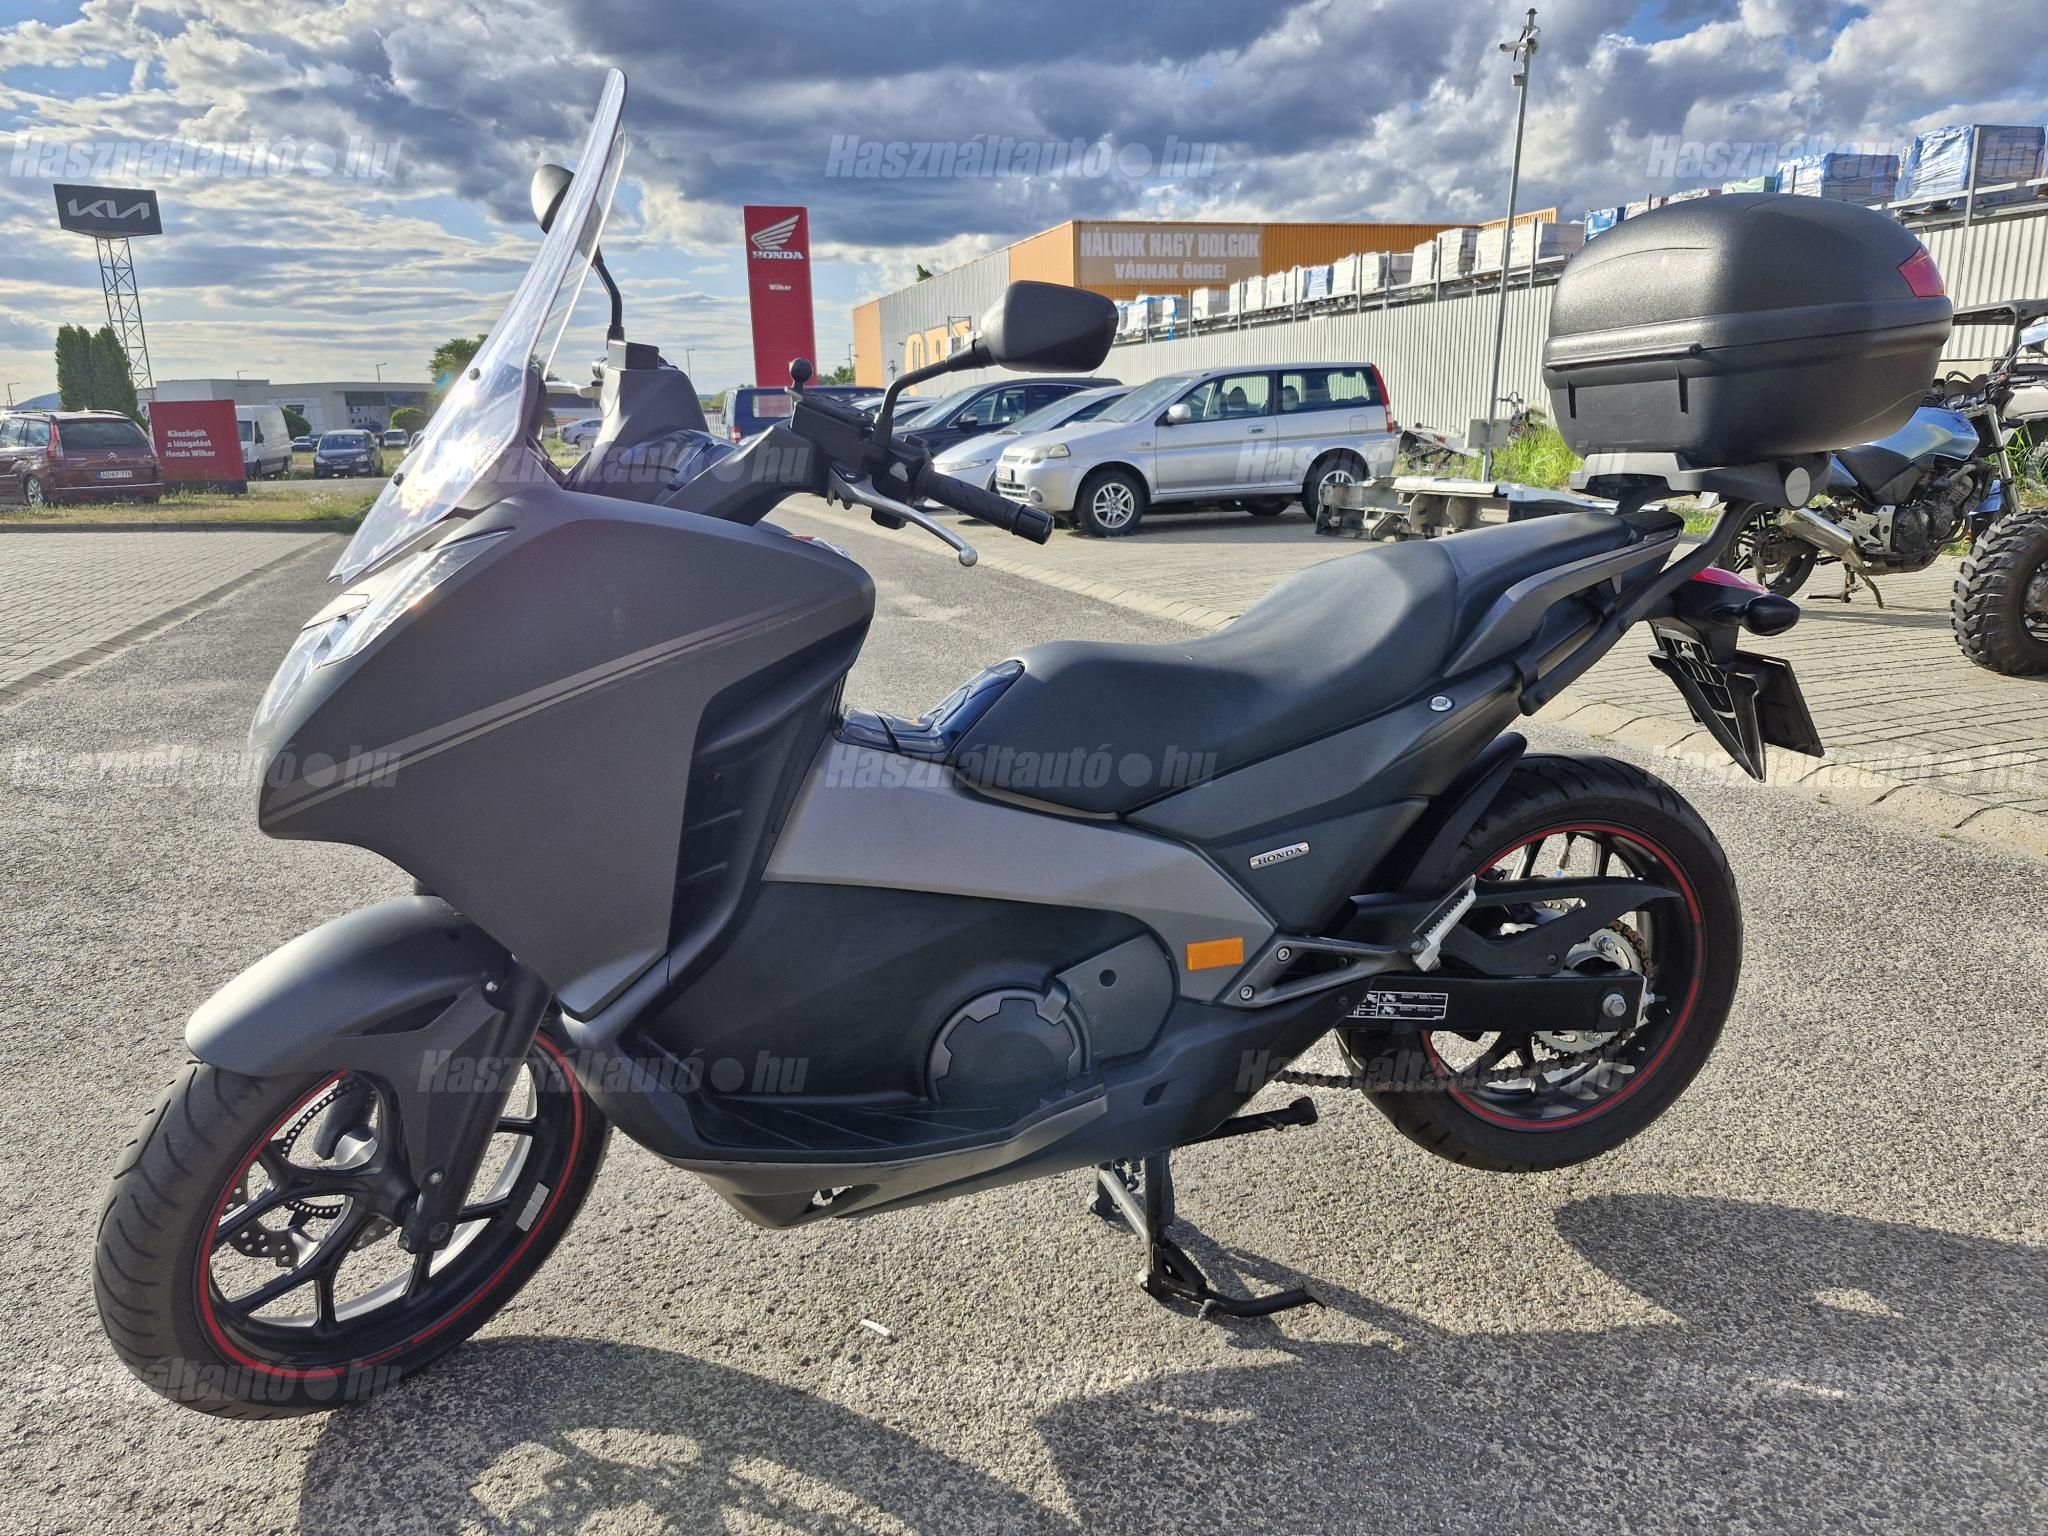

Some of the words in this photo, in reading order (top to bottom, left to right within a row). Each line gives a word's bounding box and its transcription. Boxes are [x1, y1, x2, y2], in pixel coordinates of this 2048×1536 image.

[1080, 227, 1146, 257] NÁLUNK
[1150, 233, 1194, 257] NAGY
[1198, 233, 1260, 257] DOLGOK
[752, 250, 804, 260] HONDA
[1114, 261, 1179, 279] VÁRNAK
[1183, 261, 1227, 279] ÖNRE!
[174, 440, 211, 449] látogatást
[166, 450, 190, 458] Honda
[1258, 847, 1303, 865] HONDA
